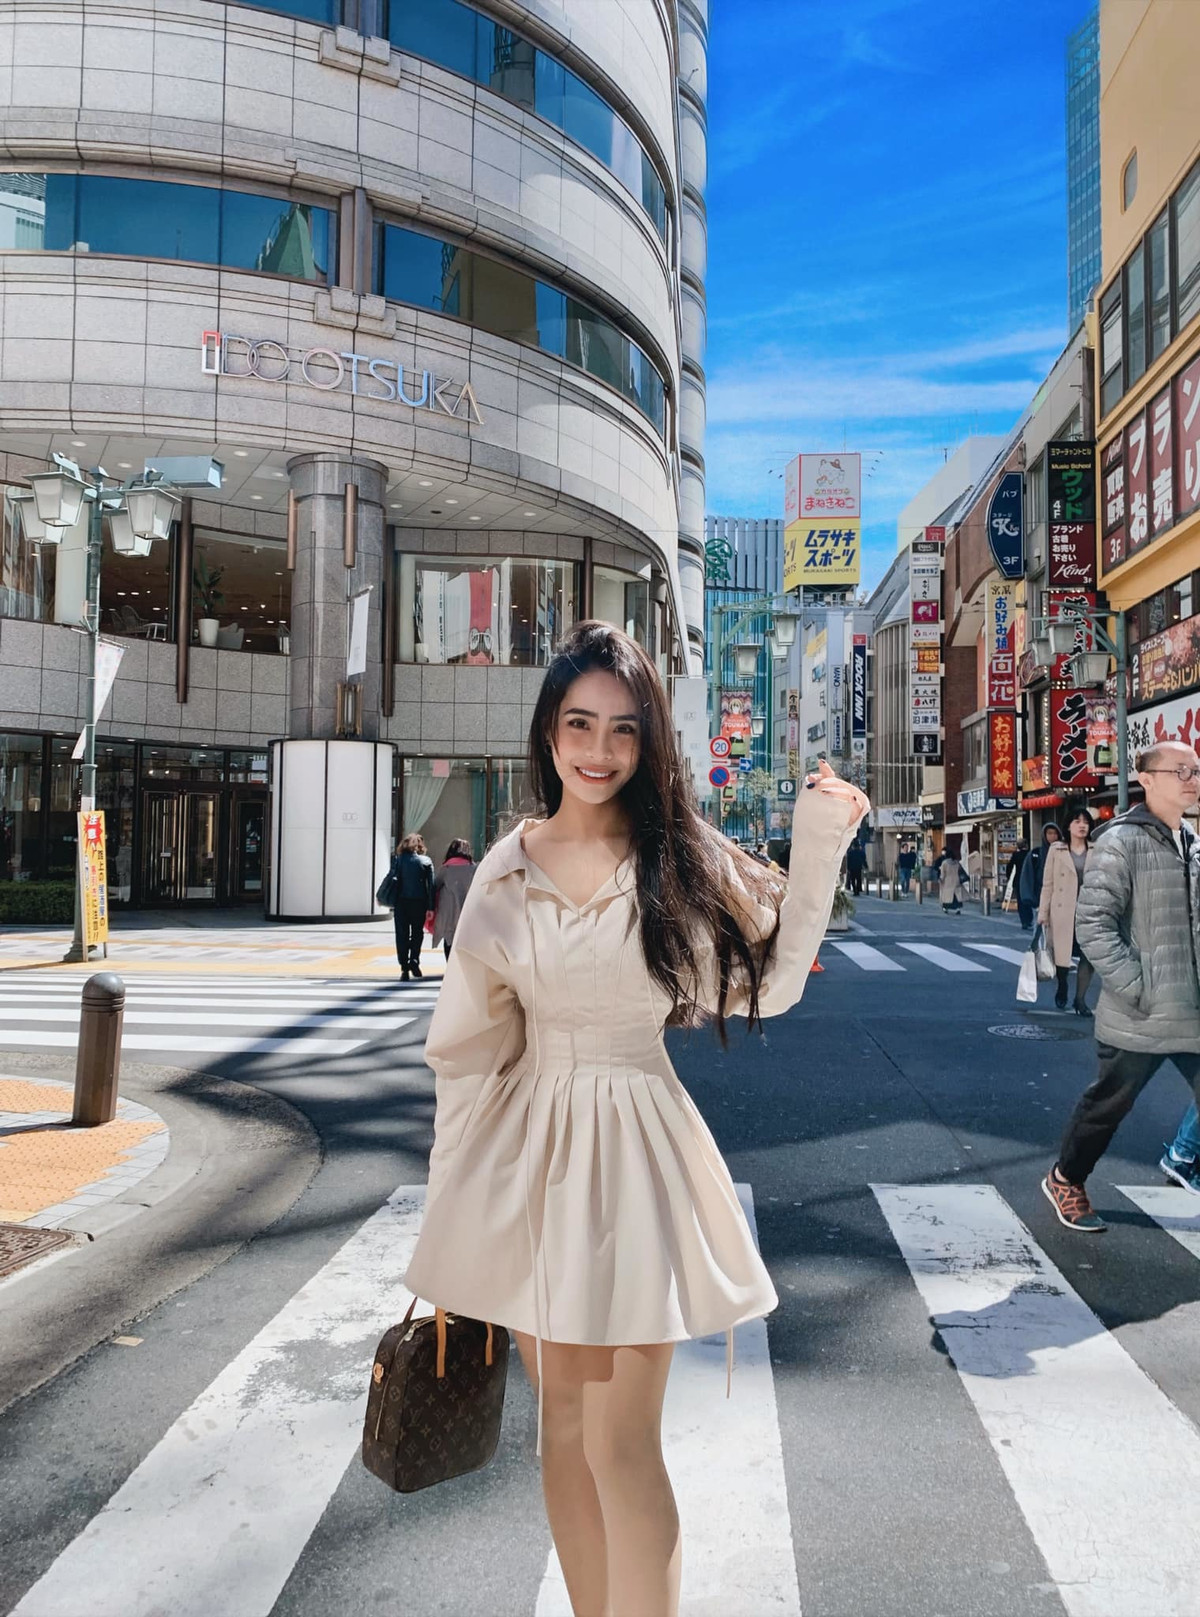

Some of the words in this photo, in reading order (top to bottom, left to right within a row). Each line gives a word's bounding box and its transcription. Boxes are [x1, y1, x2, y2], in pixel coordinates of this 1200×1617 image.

[302, 347, 484, 425] OTSUKA
[804, 496, 855, 511] まねきねこ
[1002, 490, 1018, 499] パブ
[1062, 469, 1083, 520] ウッド
[1053, 500, 1061, 518] 4F
[1052, 525, 1084, 533] ブランド
[804, 529, 856, 548] ムラサキ
[1052, 534, 1068, 543] 古着
[804, 548, 856, 567] スポーツ
[1052, 544, 1076, 553] お売り
[1052, 553, 1077, 562] 下さい
[1110, 534, 1121, 563] 3F
[1003, 556, 1019, 565] 3F
[1053, 564, 1092, 579] Kind
[854, 653, 864, 695] ROCK
[991, 653, 1014, 701] 百花
[1132, 654, 1140, 698] 2F
[854, 694, 864, 721] INN
[714, 742, 727, 752] 20
[993, 716, 1013, 789] お好み焼
